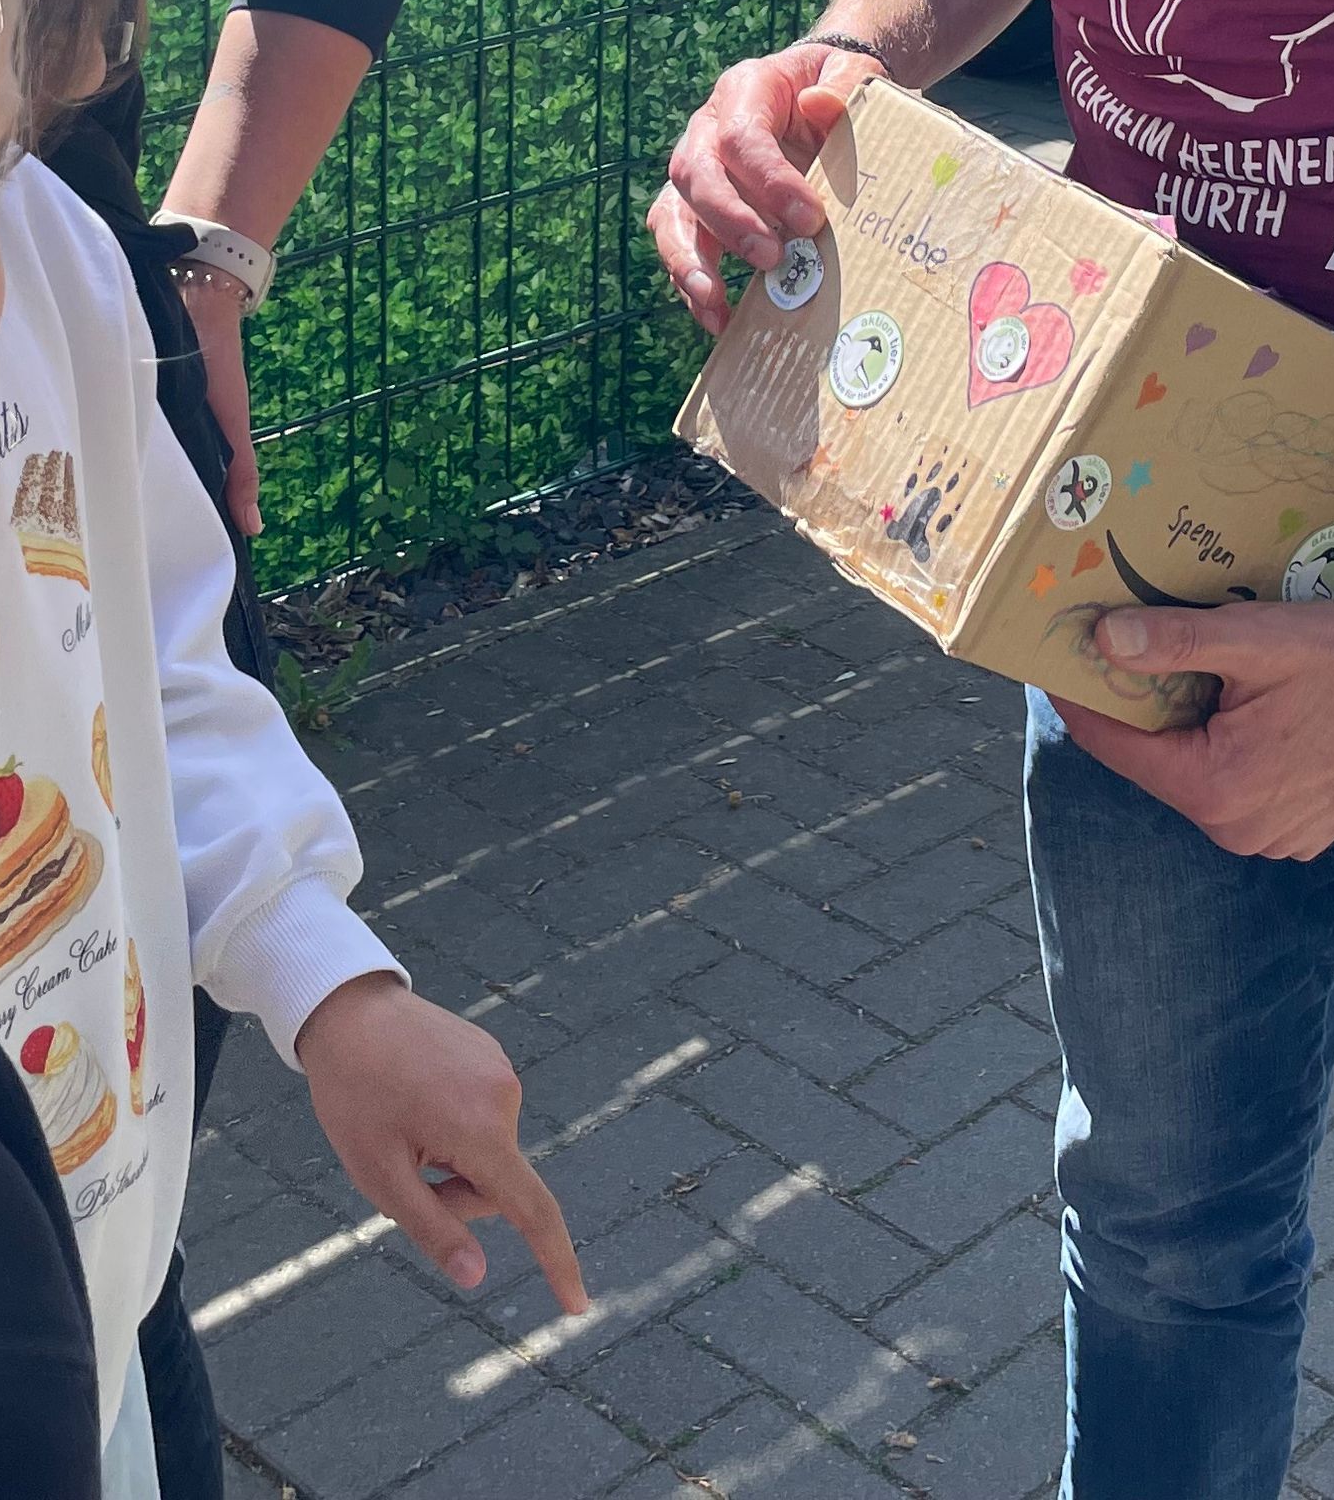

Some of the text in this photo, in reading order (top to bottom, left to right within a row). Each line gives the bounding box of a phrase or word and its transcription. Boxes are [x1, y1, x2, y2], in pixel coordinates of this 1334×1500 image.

[1066, 50, 1176, 162] TIERHEIM
[842, 170, 948, 275] Tierliebe
[1154, 172, 1288, 238] HÜRTH
[860, 313, 900, 366] aktion tier
[1168, 504, 1236, 570] Spenden
[15, 965, 72, 1011] Cream
[69, 929, 117, 973] Cake
